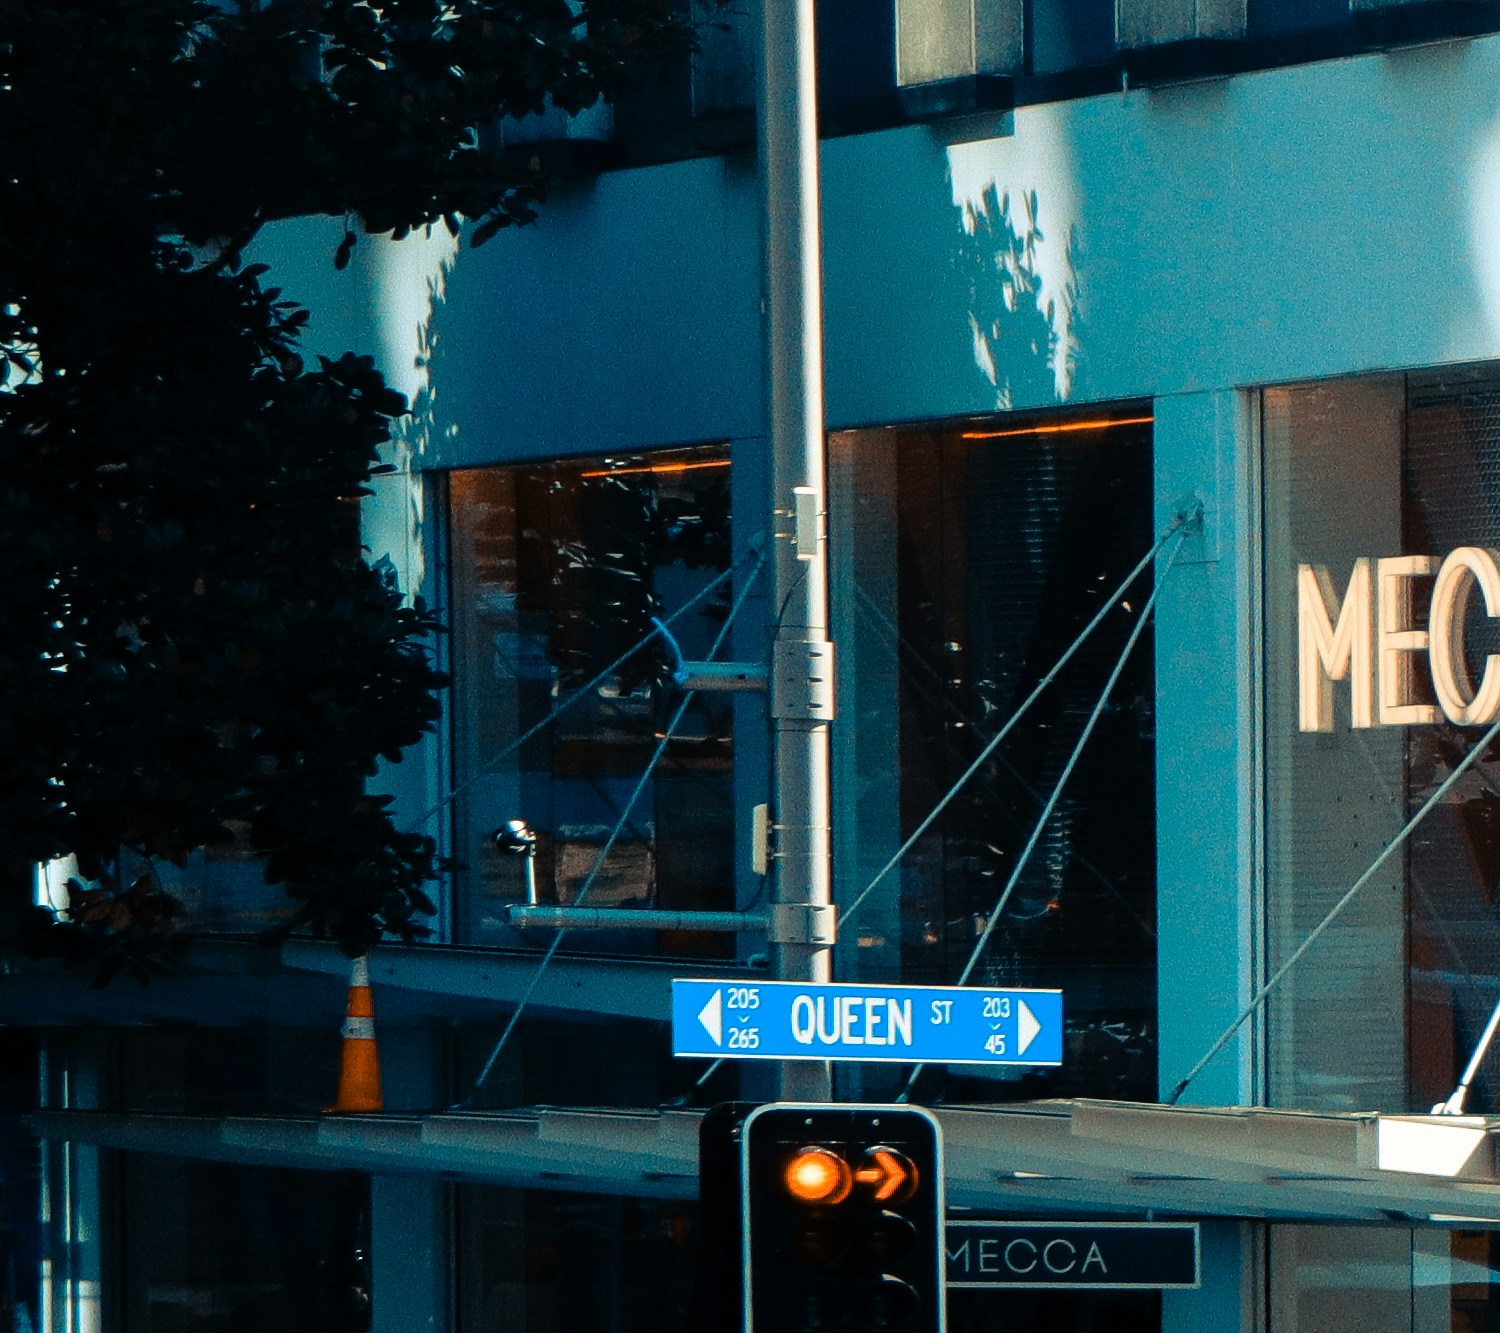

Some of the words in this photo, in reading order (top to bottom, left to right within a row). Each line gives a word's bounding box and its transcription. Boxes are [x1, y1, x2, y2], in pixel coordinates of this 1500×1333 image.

[727, 988, 760, 1009] 205
[982, 998, 1010, 1018] 203
[791, 994, 912, 1046] QUEEN
[931, 1001, 954, 1025] ST
[728, 1028, 759, 1049] 265
[984, 1034, 1006, 1055] 45
[945, 1239, 1108, 1274] MECCA
